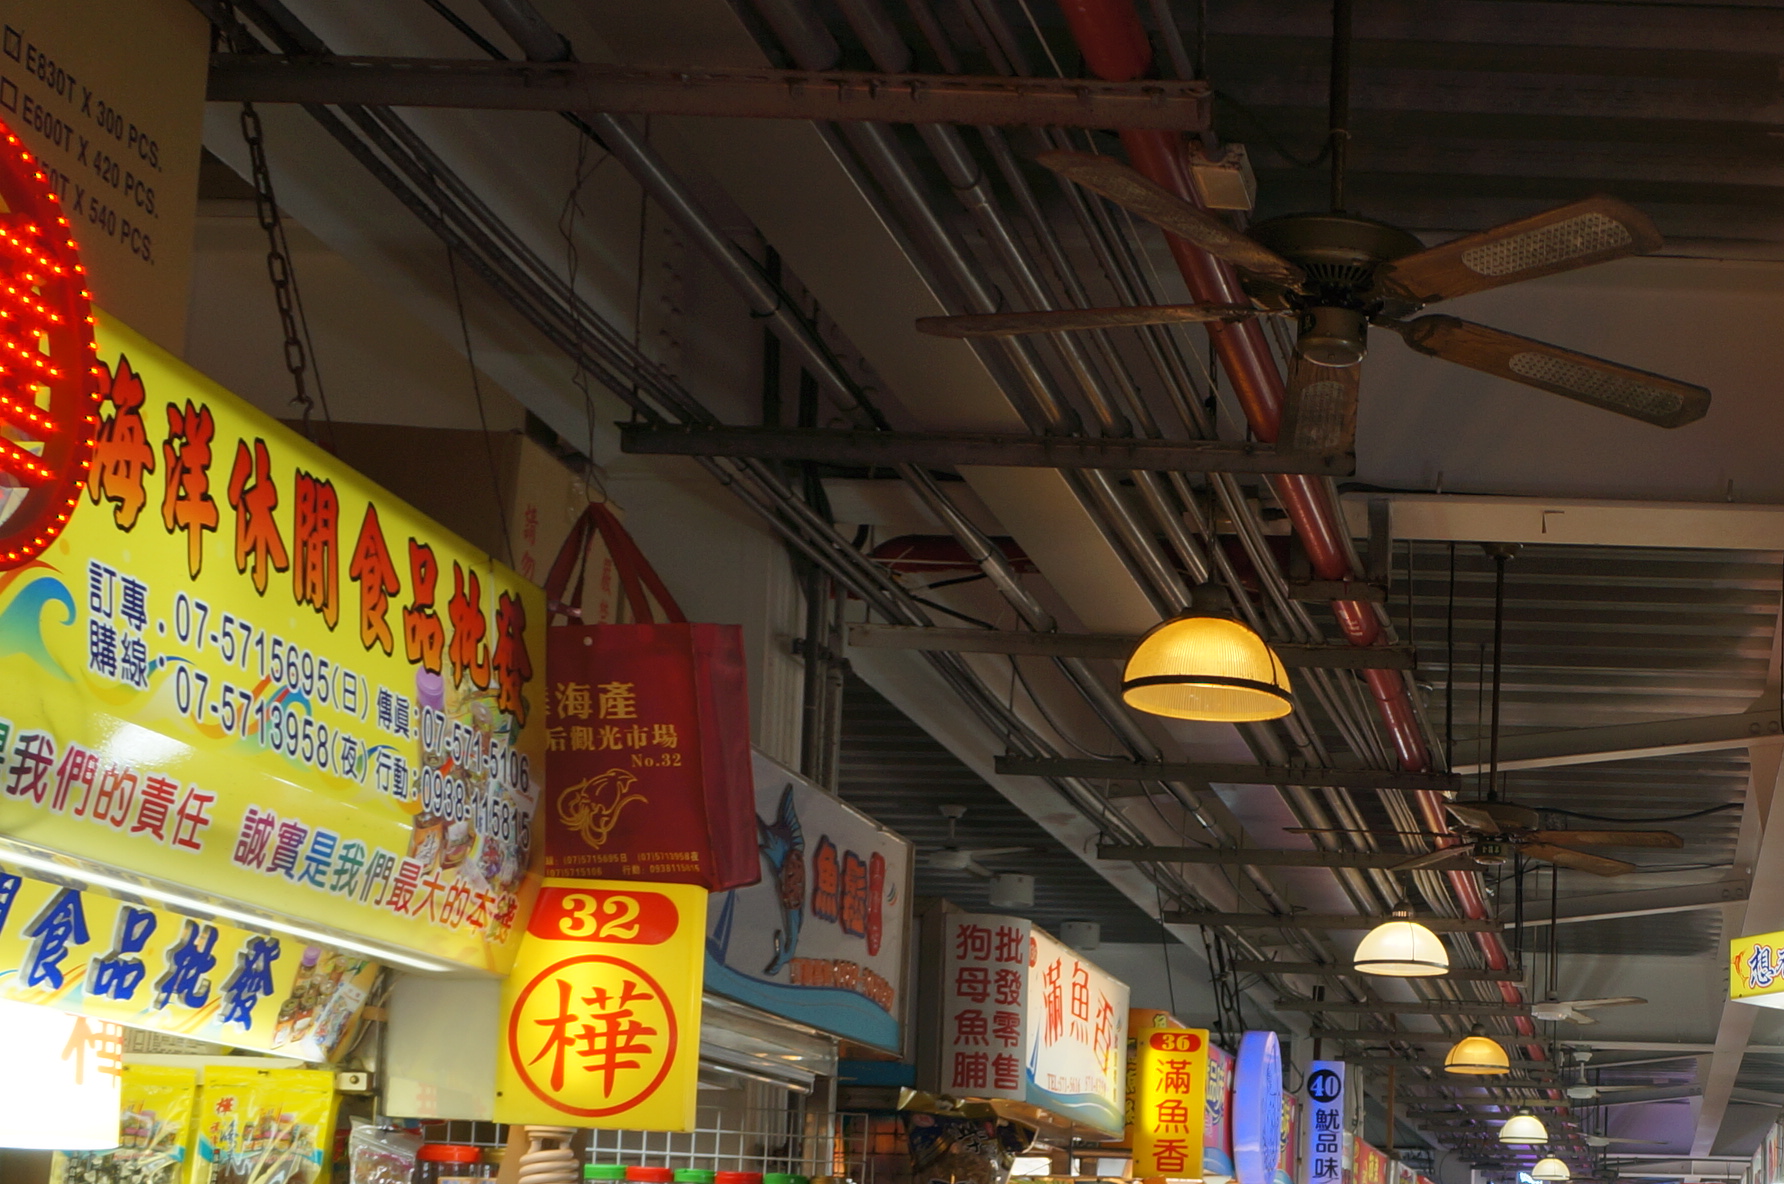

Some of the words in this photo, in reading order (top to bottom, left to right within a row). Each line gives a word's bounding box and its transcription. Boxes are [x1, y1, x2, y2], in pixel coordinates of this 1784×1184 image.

[26, 43, 76, 103] E830T
[97, 100, 123, 141] 300
[128, 123, 162, 173] PCS.
[22, 94, 74, 153] E600T
[93, 151, 120, 189] 420
[124, 172, 159, 219] PCS.
[88, 198, 117, 237] 540
[120, 219, 155, 266] PCS.
[545, 681, 638, 722] 海產
[631, 753, 682, 768] No.32
[558, 895, 641, 938] 32
[528, 978, 659, 1100] 樺
[952, 923, 992, 1088] 狗母魚脯
[992, 925, 1025, 1089] 批發零售
[1043, 957, 1114, 1075] 滿魚香
[1162, 1034, 1190, 1050] 36
[1152, 1059, 1192, 1173] 滿魚香
[1310, 1075, 1341, 1098] 40
[1315, 1108, 1340, 1180] 魷品味
